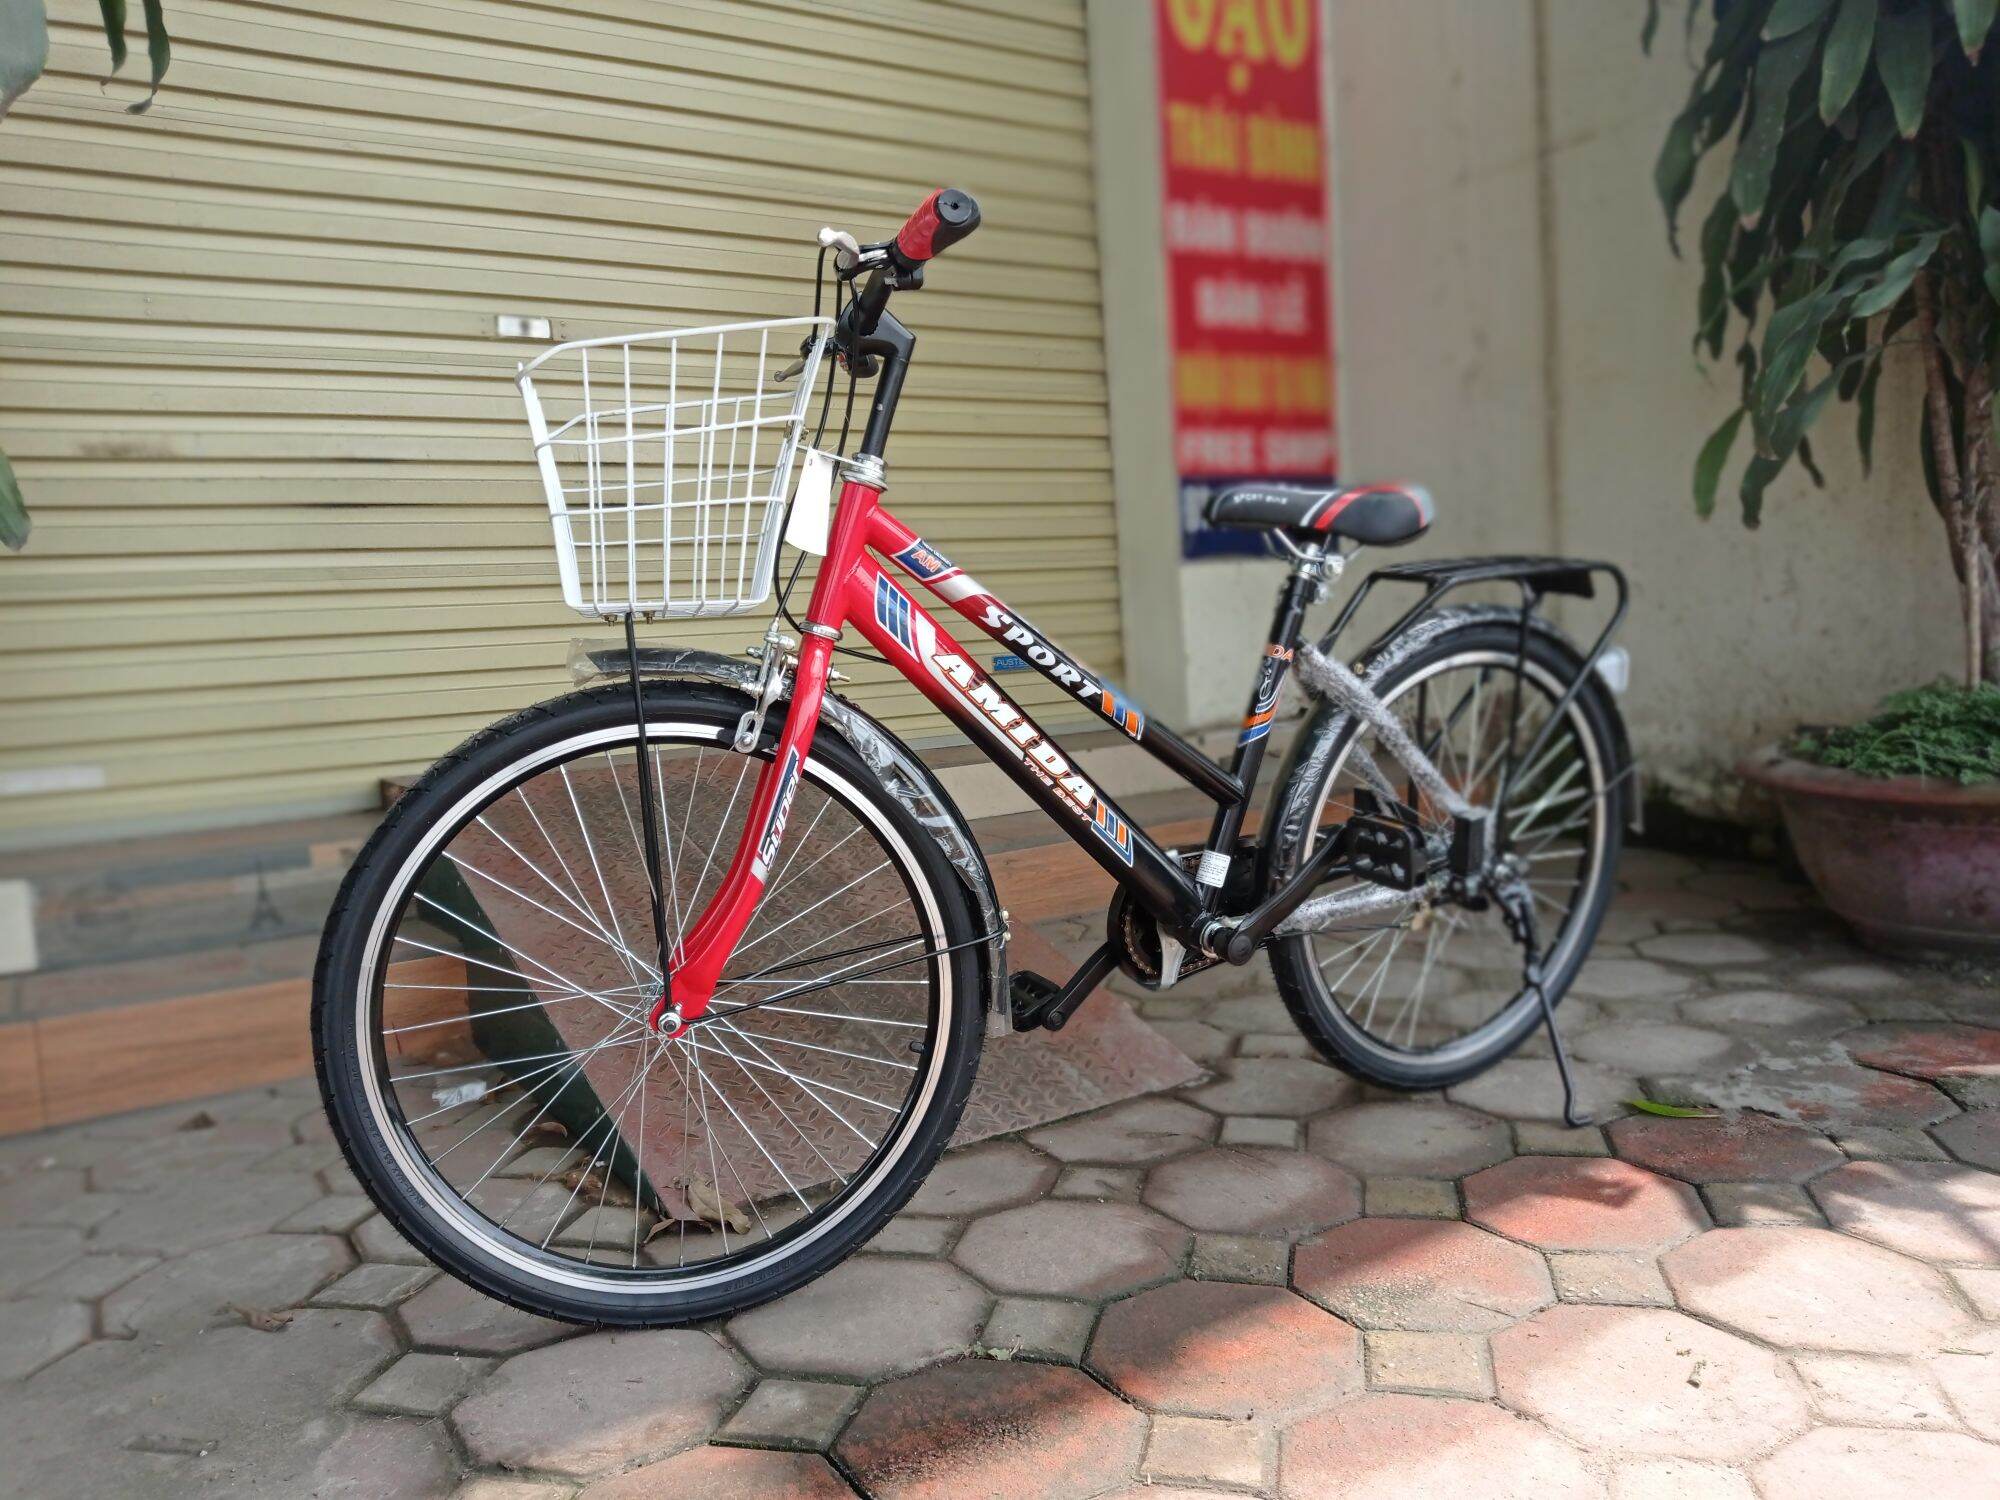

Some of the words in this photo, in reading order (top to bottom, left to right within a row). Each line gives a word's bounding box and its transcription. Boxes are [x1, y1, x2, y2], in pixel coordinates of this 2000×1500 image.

[978, 604, 1102, 698] SPORT
[932, 652, 1097, 809] AMIDA
[1023, 757, 1054, 787] THE
[1052, 786, 1093, 823] BEST
